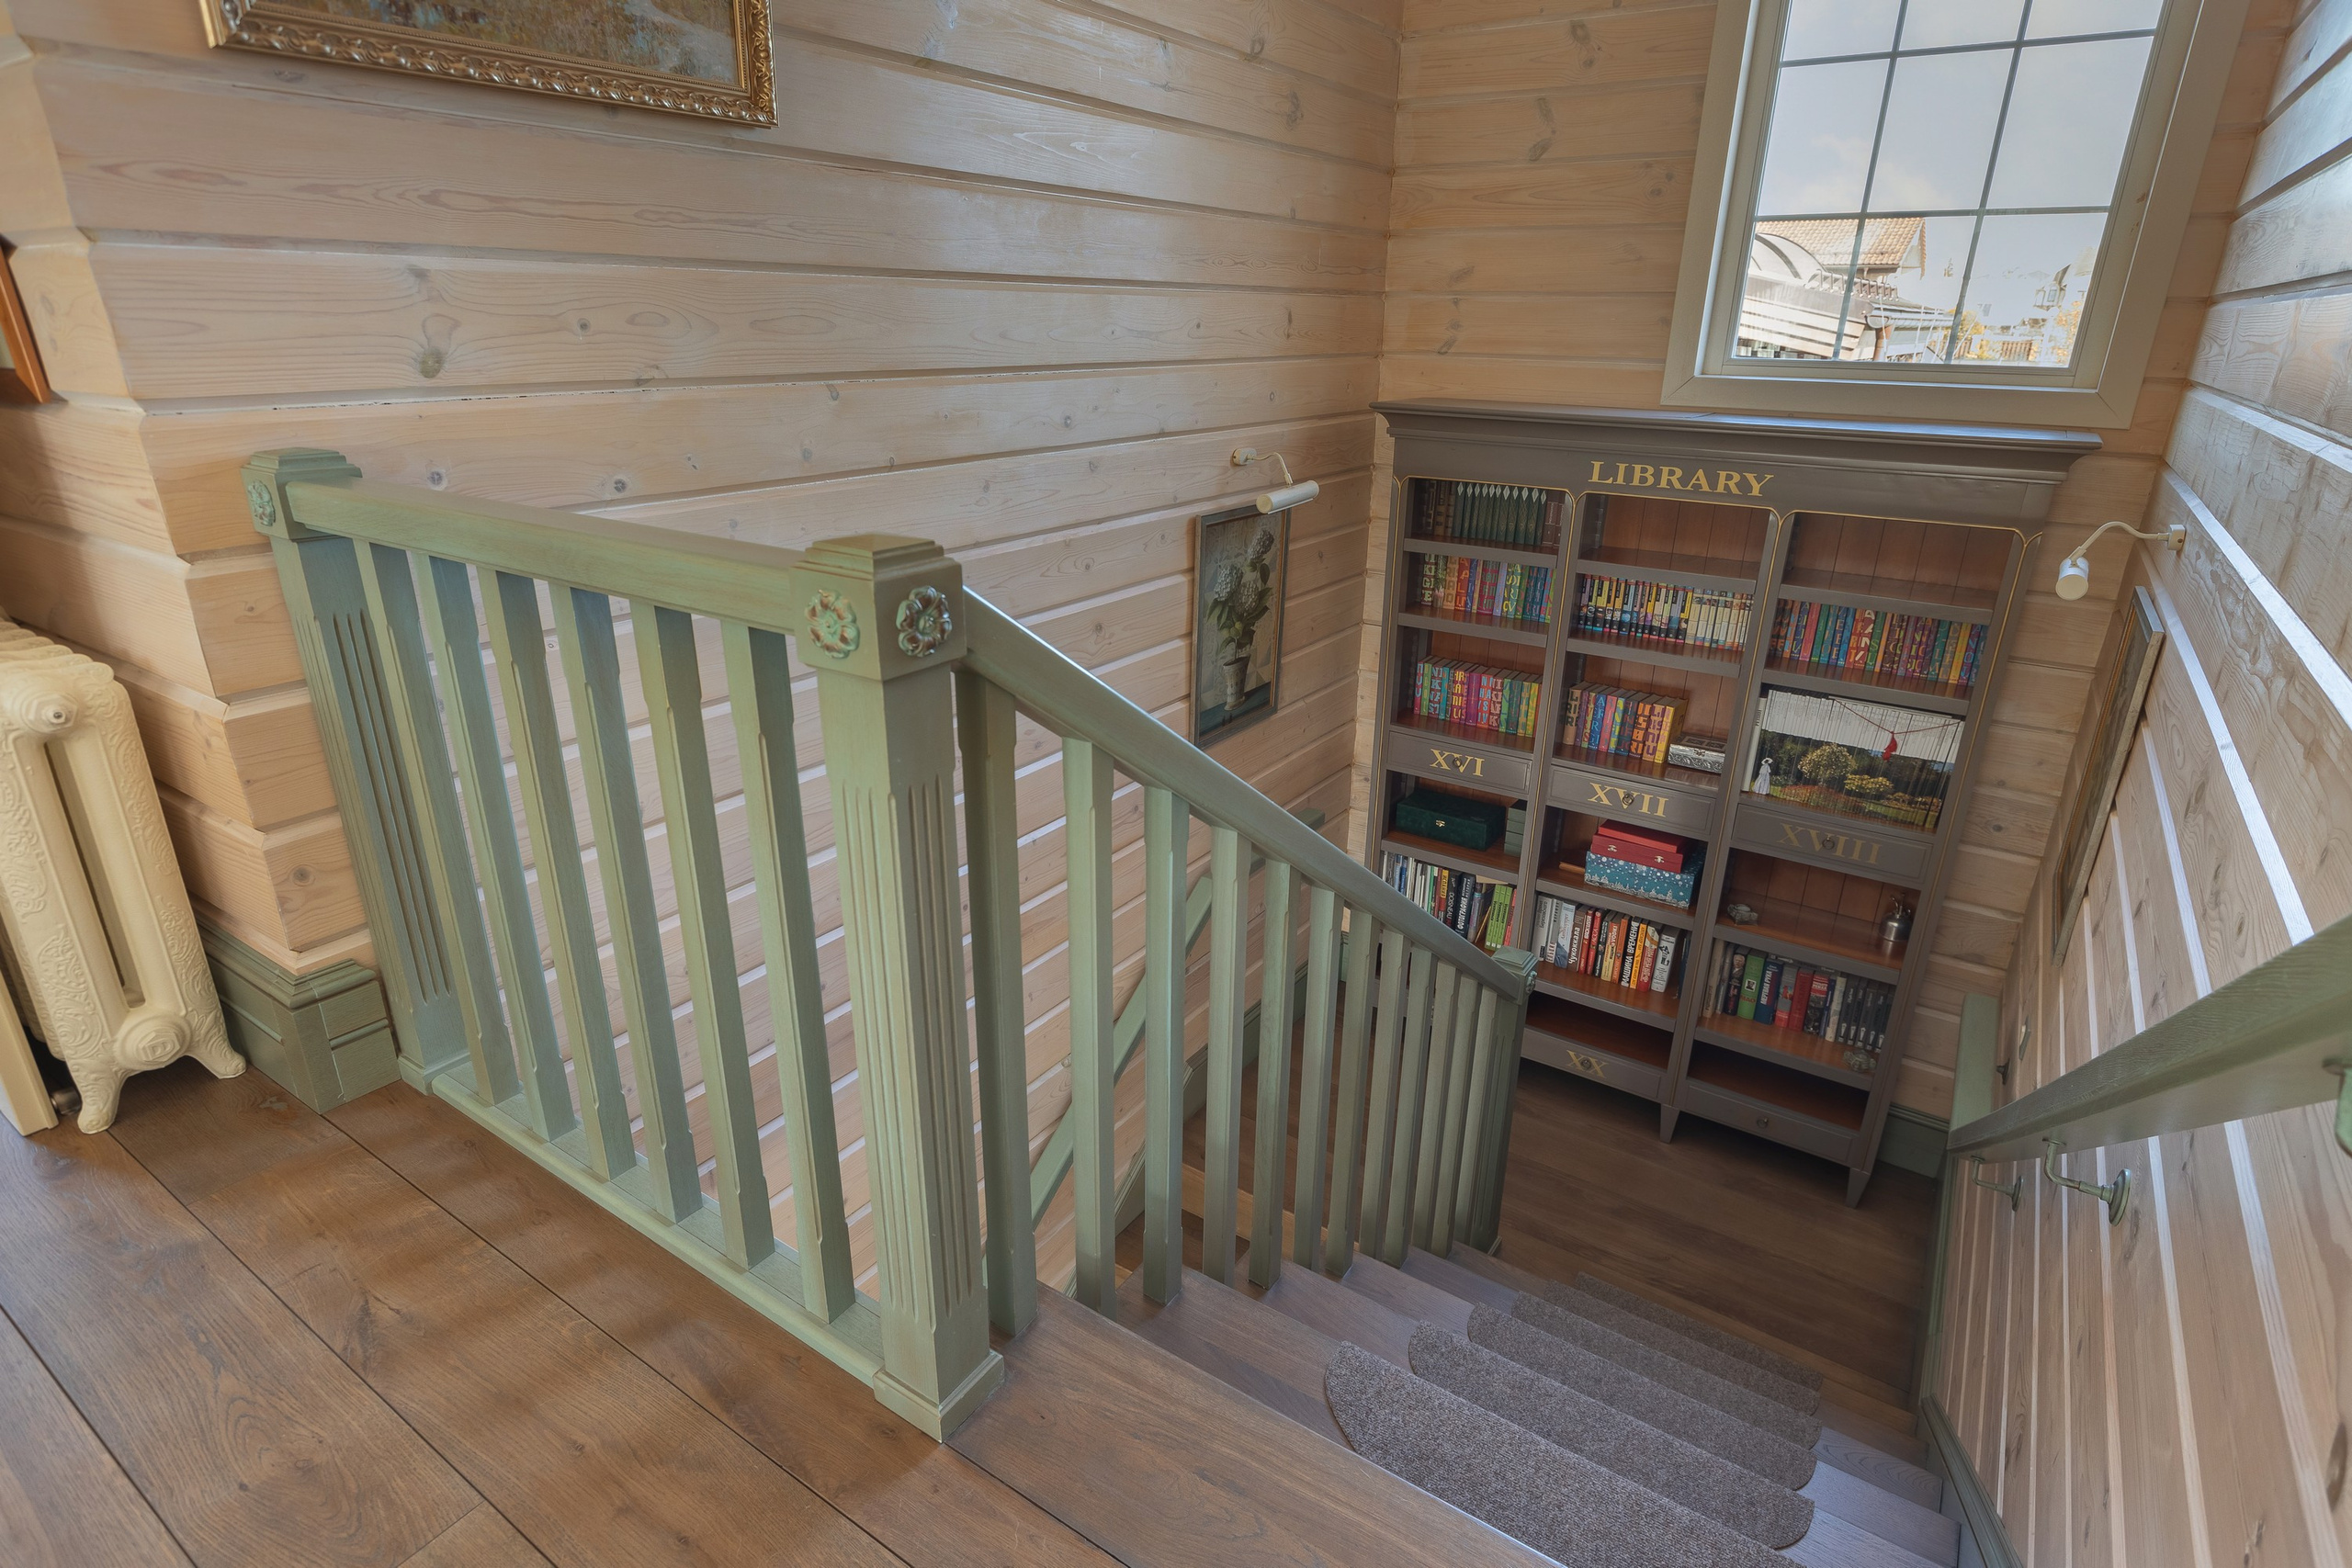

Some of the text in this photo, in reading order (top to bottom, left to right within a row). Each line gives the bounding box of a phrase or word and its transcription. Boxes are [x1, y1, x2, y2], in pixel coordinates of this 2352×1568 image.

[1588, 460, 1774, 497] LIBRARY
[1430, 748, 1486, 777] XVI
[1588, 782, 1669, 818] XVII
[1777, 822, 1883, 864] XVIII
[1567, 927, 1580, 964] Чукоккала
[1626, 920, 1640, 954] ВРЕМЕНИ
[1621, 955, 1634, 987] МАШИНА
[1566, 1049, 1609, 1079] XX
